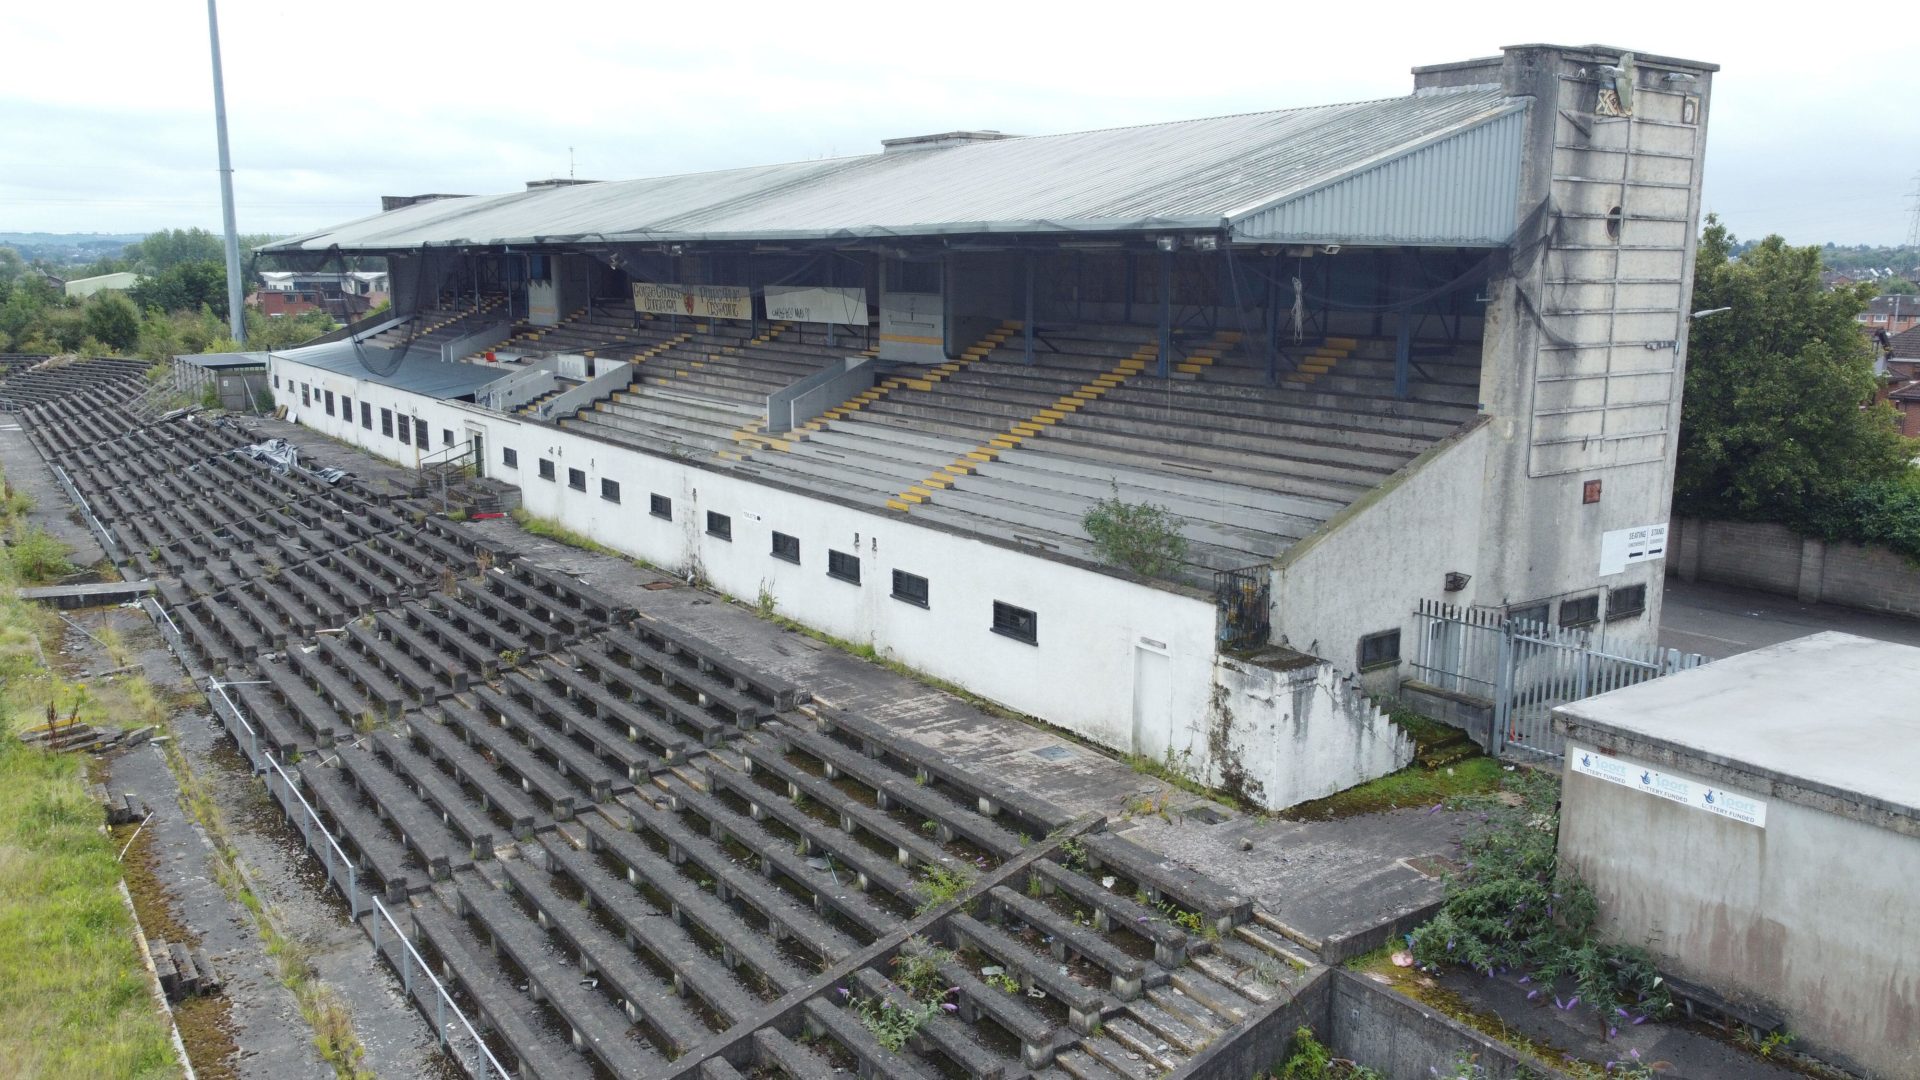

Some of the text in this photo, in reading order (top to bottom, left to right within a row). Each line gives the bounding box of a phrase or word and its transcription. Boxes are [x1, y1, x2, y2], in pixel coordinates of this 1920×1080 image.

[1603, 773, 1626, 784] FUNDED
[1664, 792, 1688, 803] FUNDED
[1729, 811, 1755, 823] FUNDED
